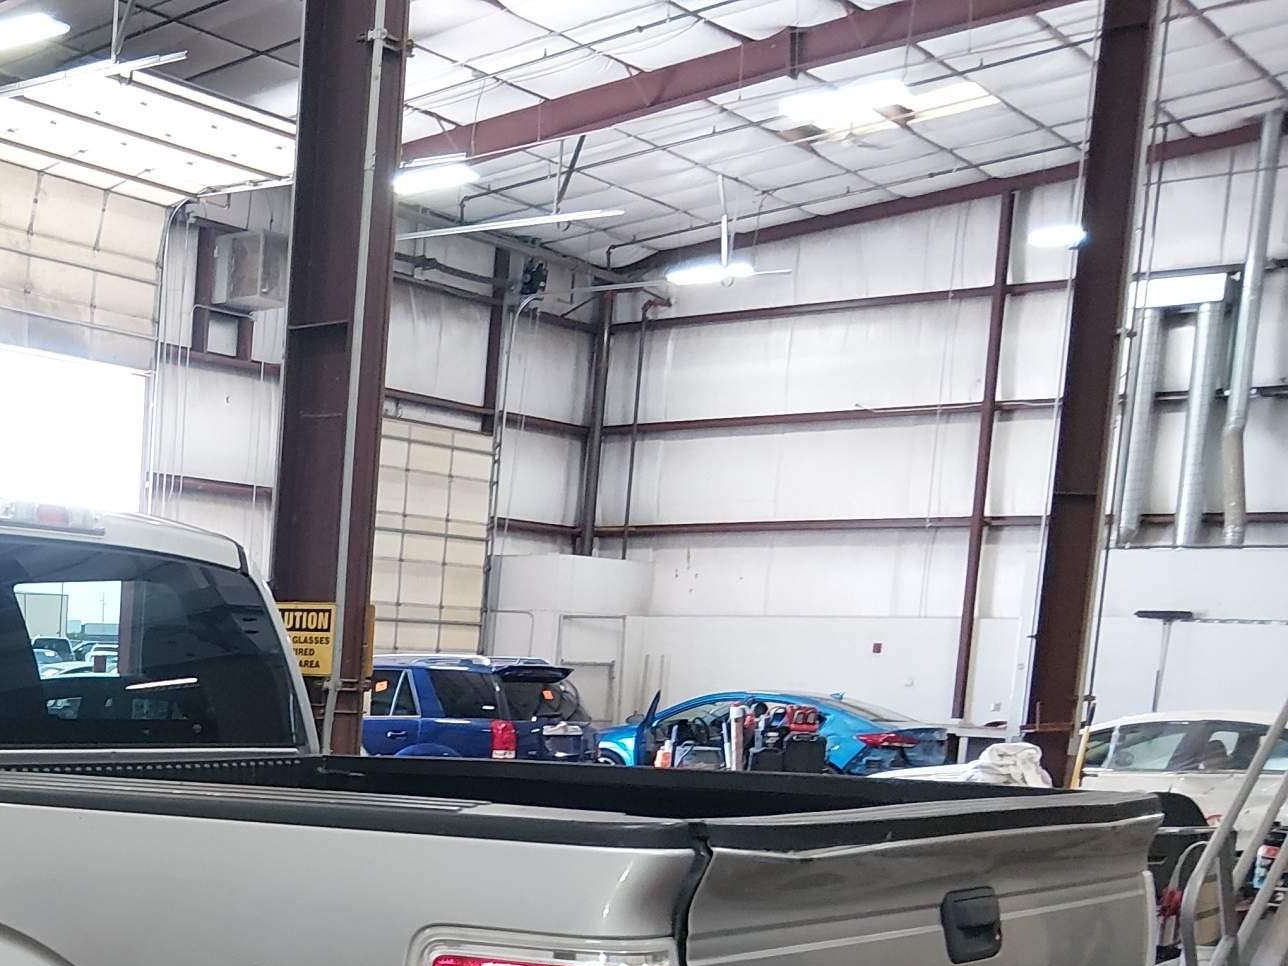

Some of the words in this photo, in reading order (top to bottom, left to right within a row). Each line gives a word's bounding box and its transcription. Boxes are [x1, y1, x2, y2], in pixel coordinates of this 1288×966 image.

[281, 611, 330, 630] UTION
[292, 635, 330, 645] GLASSES
[294, 647, 316, 656] IRED
